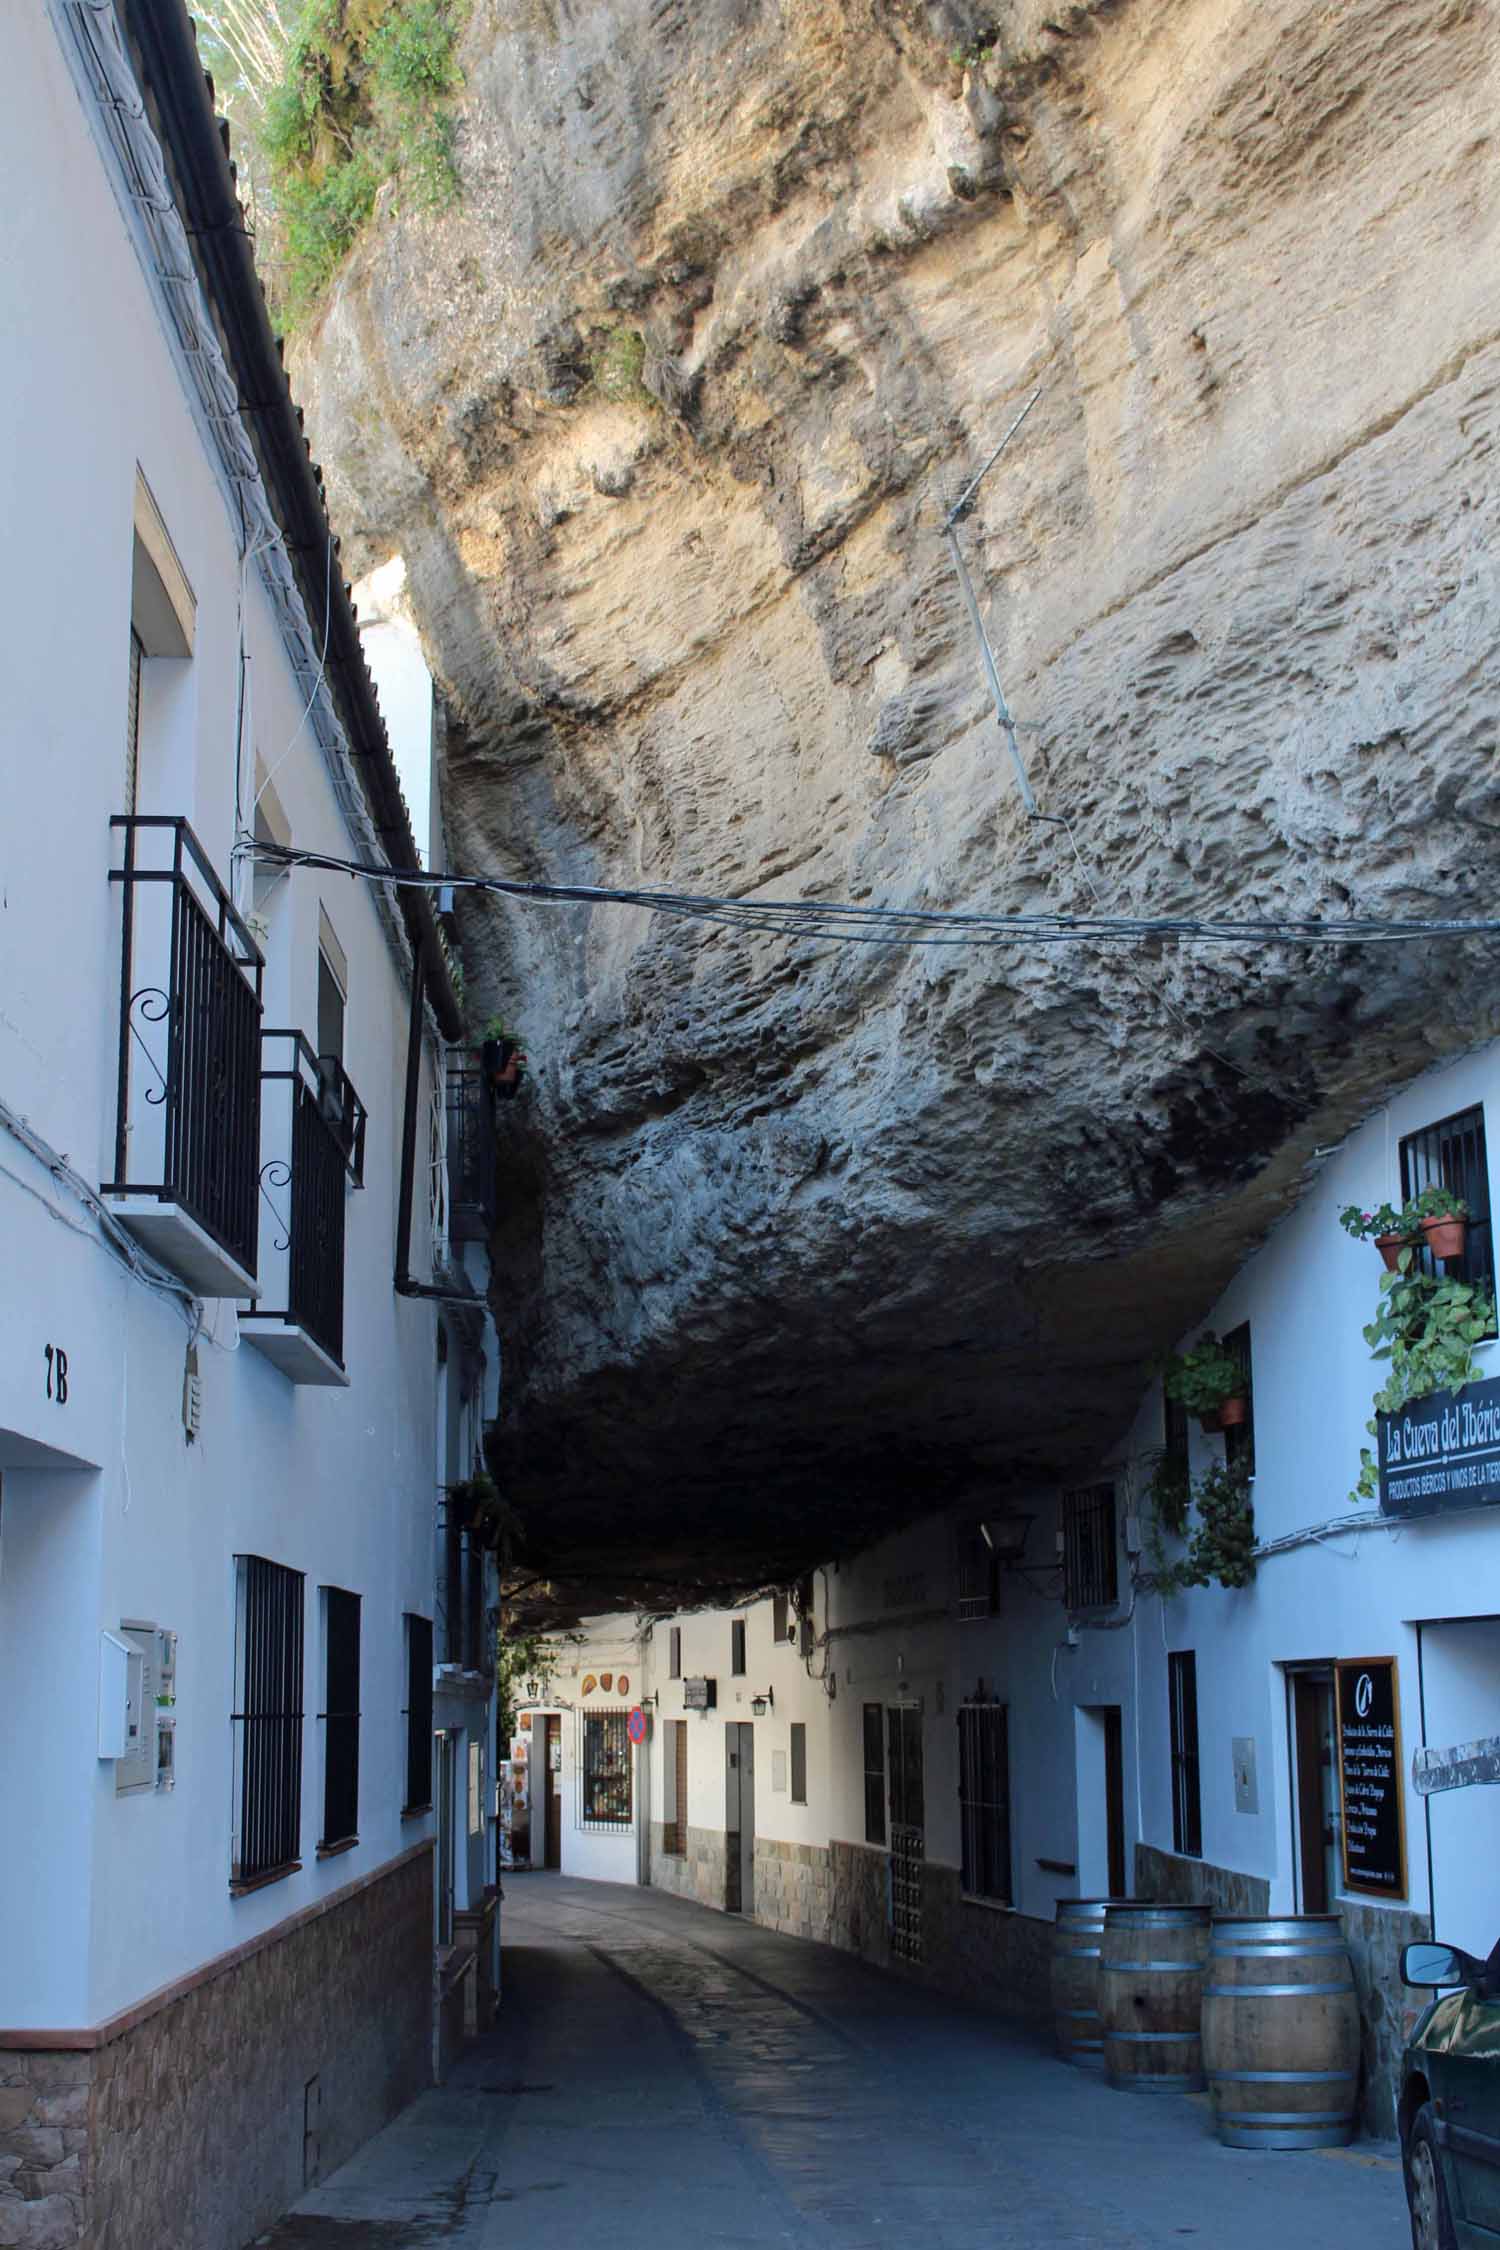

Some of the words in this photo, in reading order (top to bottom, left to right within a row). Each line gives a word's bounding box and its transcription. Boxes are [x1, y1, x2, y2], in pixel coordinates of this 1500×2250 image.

[1386, 1420, 1401, 1463] La
[1403, 1416, 1439, 1459] Cueva
[1441, 1405, 1460, 1451] del
[1462, 1400, 1500, 1447] Ibéric
[1388, 1475, 1421, 1501] PRODUCTOS
[1451, 1467, 1468, 1490] VINOS
[1468, 1465, 1477, 1487] DE
[1477, 1463, 1486, 1486] LA
